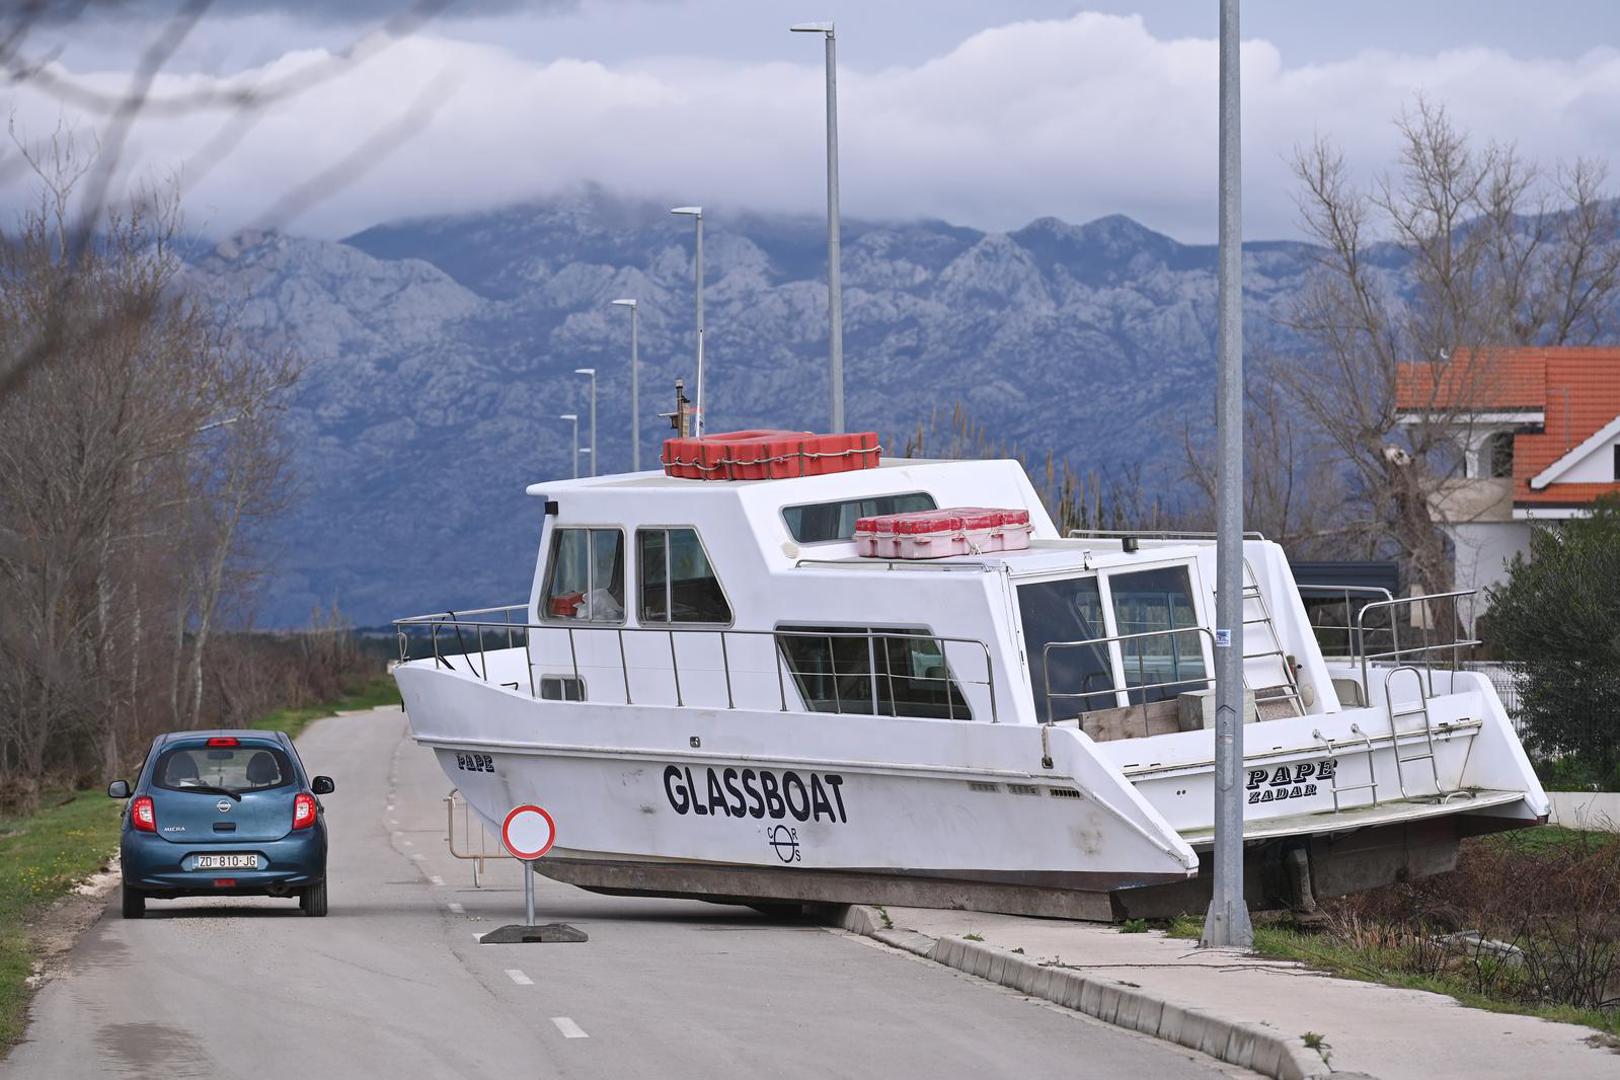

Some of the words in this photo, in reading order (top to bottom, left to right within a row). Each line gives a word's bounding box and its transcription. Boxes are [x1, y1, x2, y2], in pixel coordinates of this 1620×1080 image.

[1246, 759, 1337, 790] PAPE
[663, 765, 847, 824] GLASSBOAT
[1248, 783, 1317, 804] ZADAR
[791, 827, 798, 840] R
[200, 856, 212, 867] ZD
[795, 849, 801, 862] S
